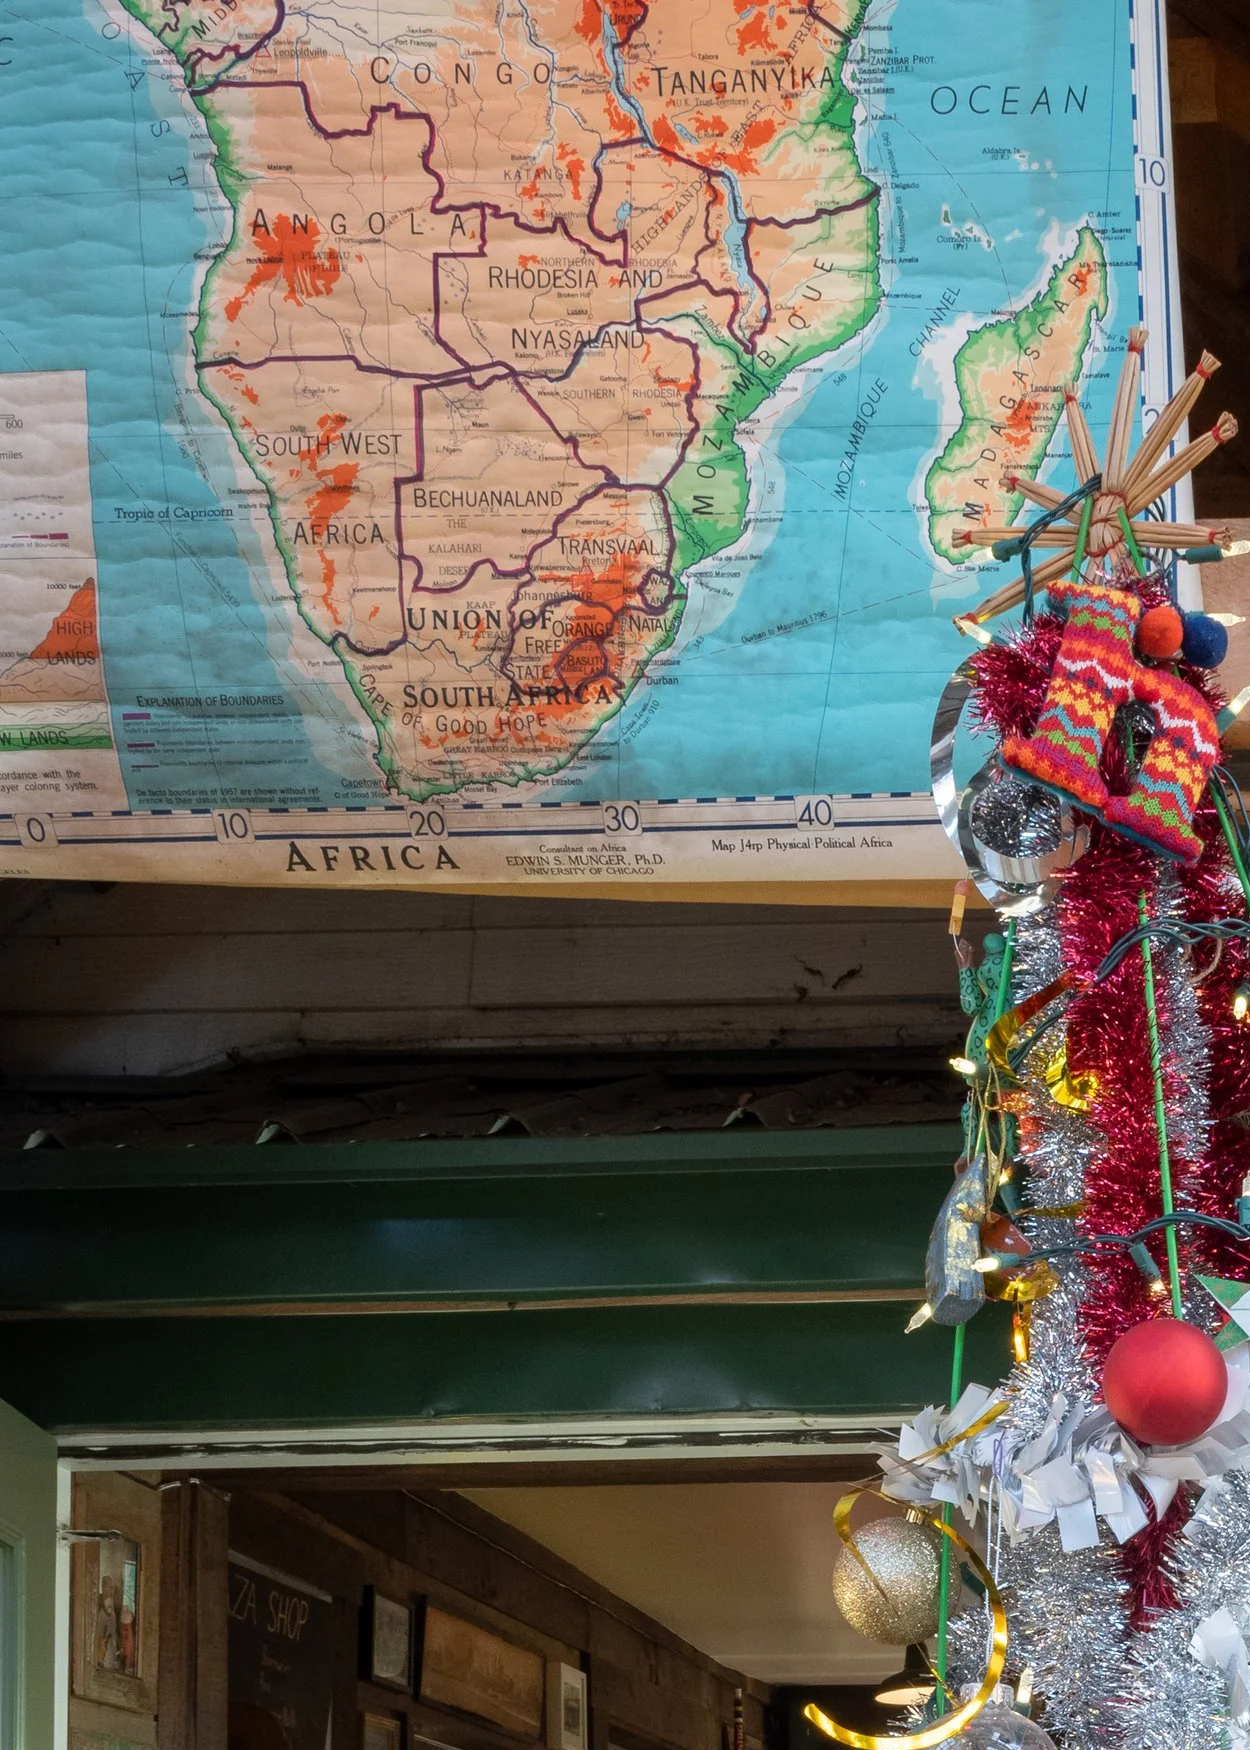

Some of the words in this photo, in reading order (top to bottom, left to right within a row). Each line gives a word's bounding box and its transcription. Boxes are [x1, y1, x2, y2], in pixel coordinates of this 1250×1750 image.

[274, 48, 328, 59] Leopoldville
[868, 47, 892, 55] Pemba
[870, 55, 910, 66] ZANZIBAR
[913, 54, 937, 65] PROT.
[370, 56, 552, 85] CONGO
[650, 65, 835, 98] TANGANYIKA
[930, 85, 1089, 115] OCEAN
[630, 173, 709, 253] HIGHLANDS
[730, 99, 765, 144] EAST
[783, 4, 822, 66] AFRICA
[504, 169, 575, 181] KATANGA
[1138, 157, 1166, 187] 10
[890, 182, 920, 190] Delgado
[251, 208, 467, 237] ANGOLA
[936, 234, 966, 244] Comoro
[541, 257, 595, 268] NORTHERN
[630, 259, 677, 268] RHODESIA
[489, 266, 599, 289] RHODESIA
[619, 270, 663, 288] AND
[512, 328, 645, 350] NYASALAND
[563, 389, 616, 401] SOUTHERN
[633, 388, 682, 400] RHODESIA
[693, 258, 835, 515] MOZAMBIQUE
[830, 377, 889, 505] MOZAMBIQUE
[908, 286, 961, 358] CHANNEL
[962, 272, 1085, 522] MADAGASCAR
[6, 419, 24, 430] 600
[255, 434, 330, 457] SOUTH
[341, 432, 402, 455] WEST
[414, 487, 563, 509] BECHUANALAND
[115, 507, 155, 521] Tropic
[158, 506, 171, 518] of
[173, 506, 234, 521] Capricorn
[447, 519, 467, 529] THE
[293, 522, 386, 546] AFRICA
[428, 543, 482, 555] KALAHARI
[557, 535, 660, 557] TRANSVAAL
[438, 566, 478, 576] DESER
[467, 601, 496, 609] KAAP
[56, 620, 94, 635] HIGH
[407, 608, 502, 631] UNION
[520, 608, 554, 631] OF
[552, 619, 614, 637] ORANGE
[629, 615, 672, 632] NATAL
[741, 631, 767, 645] Durban
[810, 611, 828, 623] 1796
[526, 638, 562, 654] FREE
[46, 651, 97, 666] LANDS
[506, 662, 549, 681] STATE
[646, 676, 679, 687] Durban
[136, 695, 202, 708] EXPLANATION
[206, 697, 218, 706] OF
[220, 694, 285, 707] BOUNDARIES
[359, 673, 394, 717] CAPE
[402, 711, 423, 730] OF
[435, 713, 488, 735] GOOD
[498, 711, 548, 732] HOPE
[404, 684, 496, 709] SOUTH
[505, 686, 613, 707] AFRICA
[20, 731, 69, 746] LANDS
[42, 770, 62, 779] with
[66, 769, 81, 779] the
[24, 782, 61, 792] coloring
[169, 788, 209, 797] boundaries
[220, 788, 238, 796] 1957
[279, 787, 306, 796] without
[341, 777, 386, 790] Capetown
[605, 805, 640, 832] 30
[797, 799, 833, 827] 40
[26, 816, 46, 843] 0
[218, 812, 249, 840] 10
[410, 810, 445, 837] 20
[539, 845, 584, 854] Consultant
[600, 844, 627, 853] Africa
[711, 840, 736, 853] Map
[860, 837, 894, 849] Africa
[285, 841, 461, 872] AFRICA
[506, 856, 550, 867] EDWIN
[553, 856, 565, 867] S.
[567, 856, 632, 869] MUNGER,
[635, 854, 666, 866] Ph.D.
[524, 867, 587, 876] UNIVERSITY
[589, 867, 604, 876] OF
[606, 867, 655, 876] CHICAGO
[267, 1590, 310, 1643] SHOP
